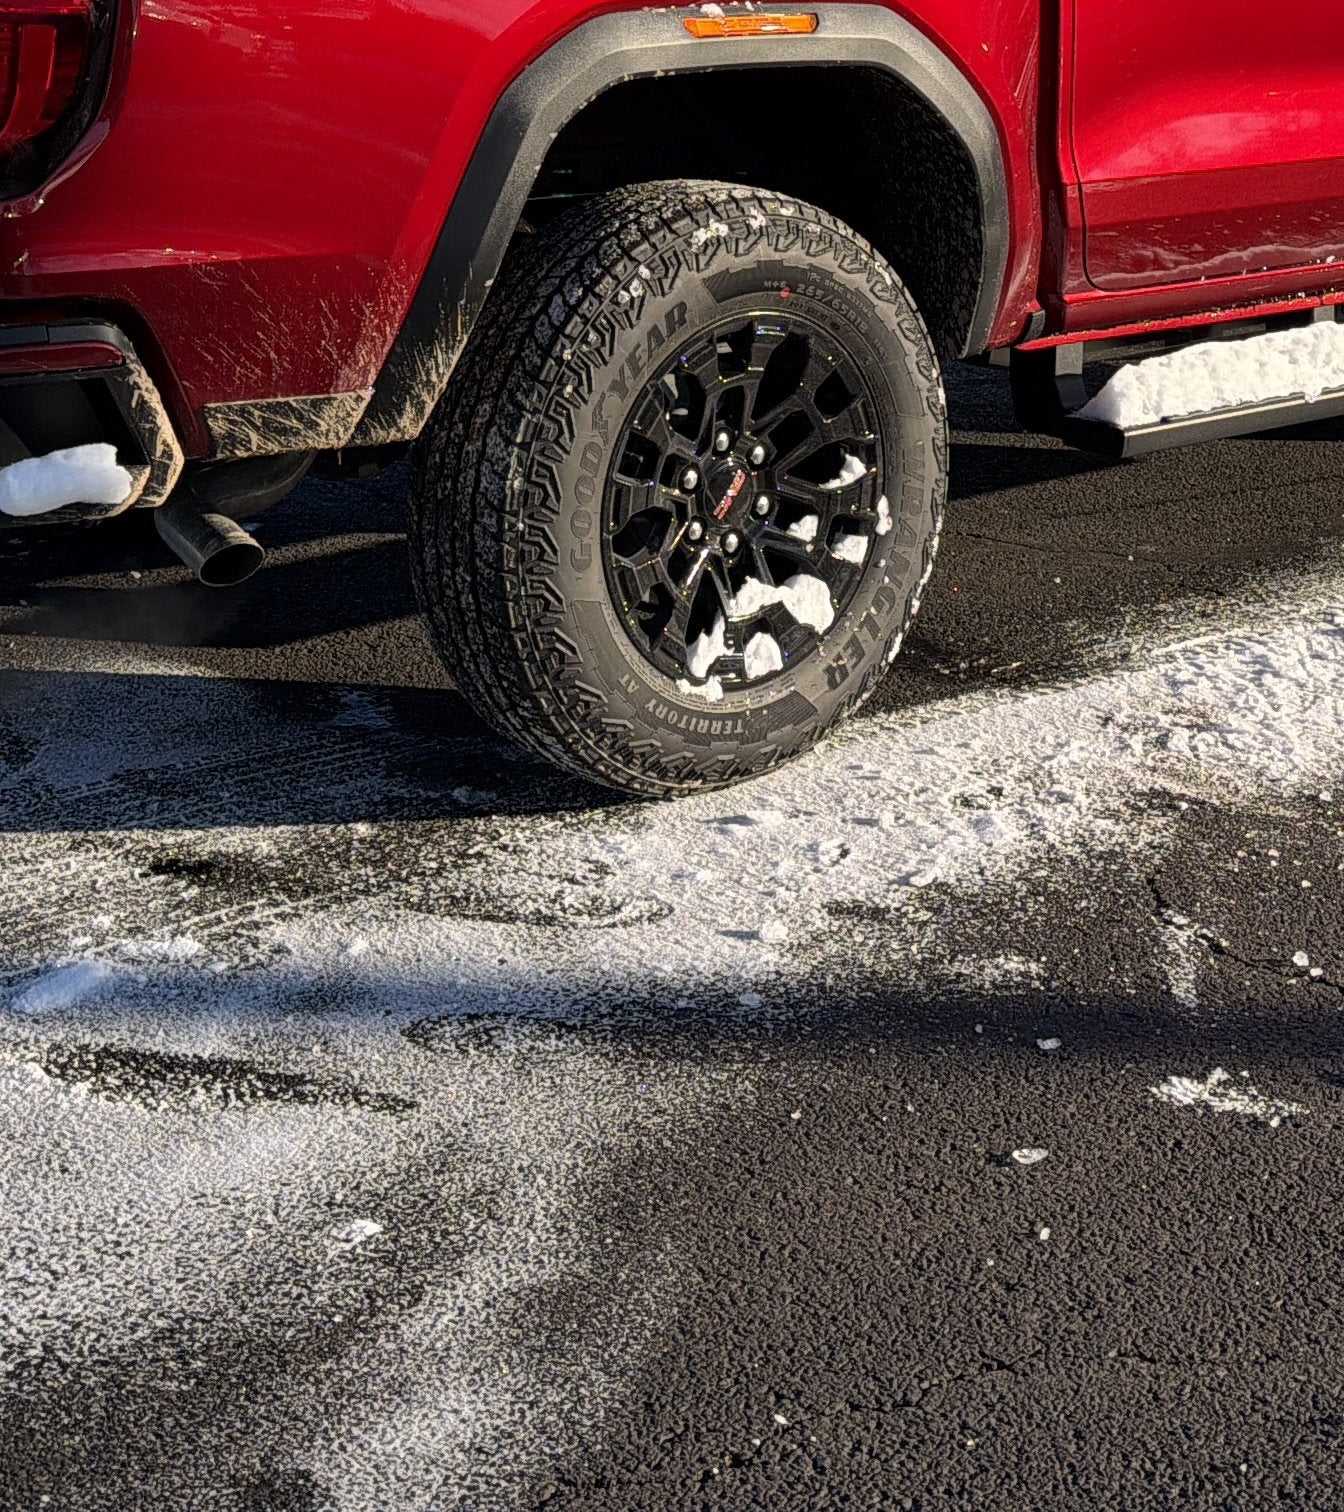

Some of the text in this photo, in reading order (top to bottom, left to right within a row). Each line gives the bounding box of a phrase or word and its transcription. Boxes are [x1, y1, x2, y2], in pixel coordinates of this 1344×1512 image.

[796, 283, 869, 334] 265/65R18
[822, 441, 926, 691] WRANGLER
[617, 672, 641, 695] AT
[644, 698, 745, 736] TERRITORY
